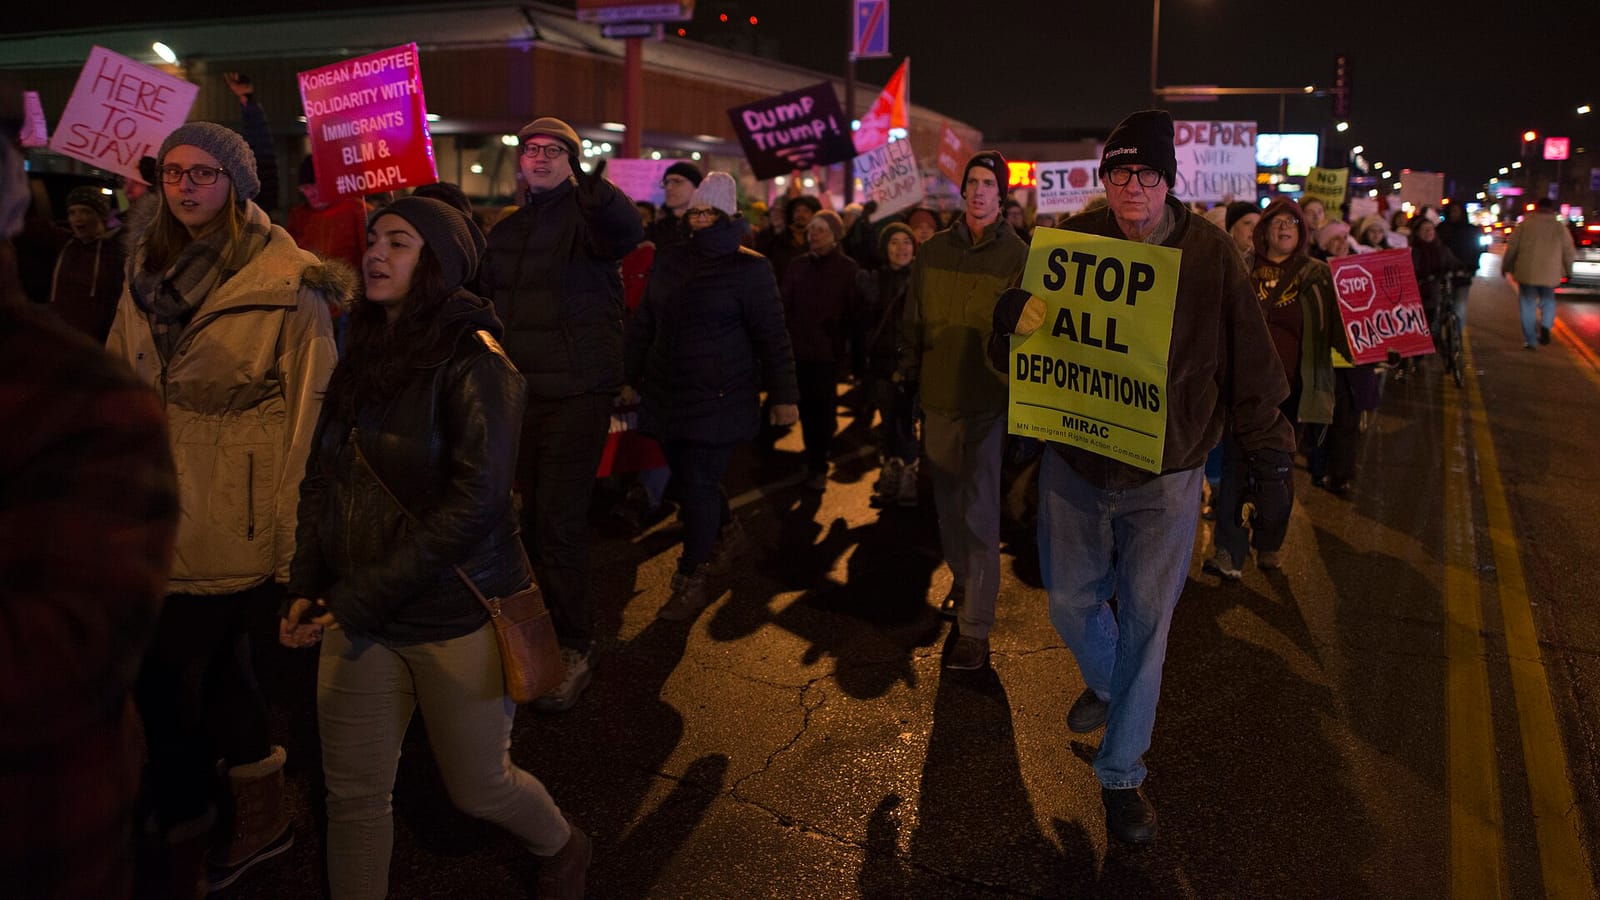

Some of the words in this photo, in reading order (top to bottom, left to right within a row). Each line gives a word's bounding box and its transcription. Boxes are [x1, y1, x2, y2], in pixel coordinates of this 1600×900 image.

[92, 56, 176, 116] HERE
[300, 68, 350, 91] KOREAN
[352, 51, 415, 80] ADOPTEE
[304, 87, 381, 118] SOLIDARITY
[380, 78, 418, 101] WITH
[102, 103, 137, 140] TO
[321, 111, 404, 142] IMMIGRANTS
[1174, 121, 1257, 148] DEPORT
[341, 142, 375, 166] BLM
[377, 139, 391, 159] &
[336, 165, 408, 195] #NoDAPL
[1316, 171, 1338, 184] NO
[1043, 247, 1156, 307] STOP
[1338, 276, 1369, 295] STOP
[1051, 307, 1129, 355] ALL
[1347, 302, 1431, 354] RACISM!
[1016, 352, 1161, 413] DEPORTATIONS
[1016, 422, 1029, 431] MN
[1031, 425, 1067, 438] Immigrant
[1068, 430, 1089, 442] Rights
[1090, 438, 1111, 450] Action
[1061, 415, 1110, 439] MIRAC
